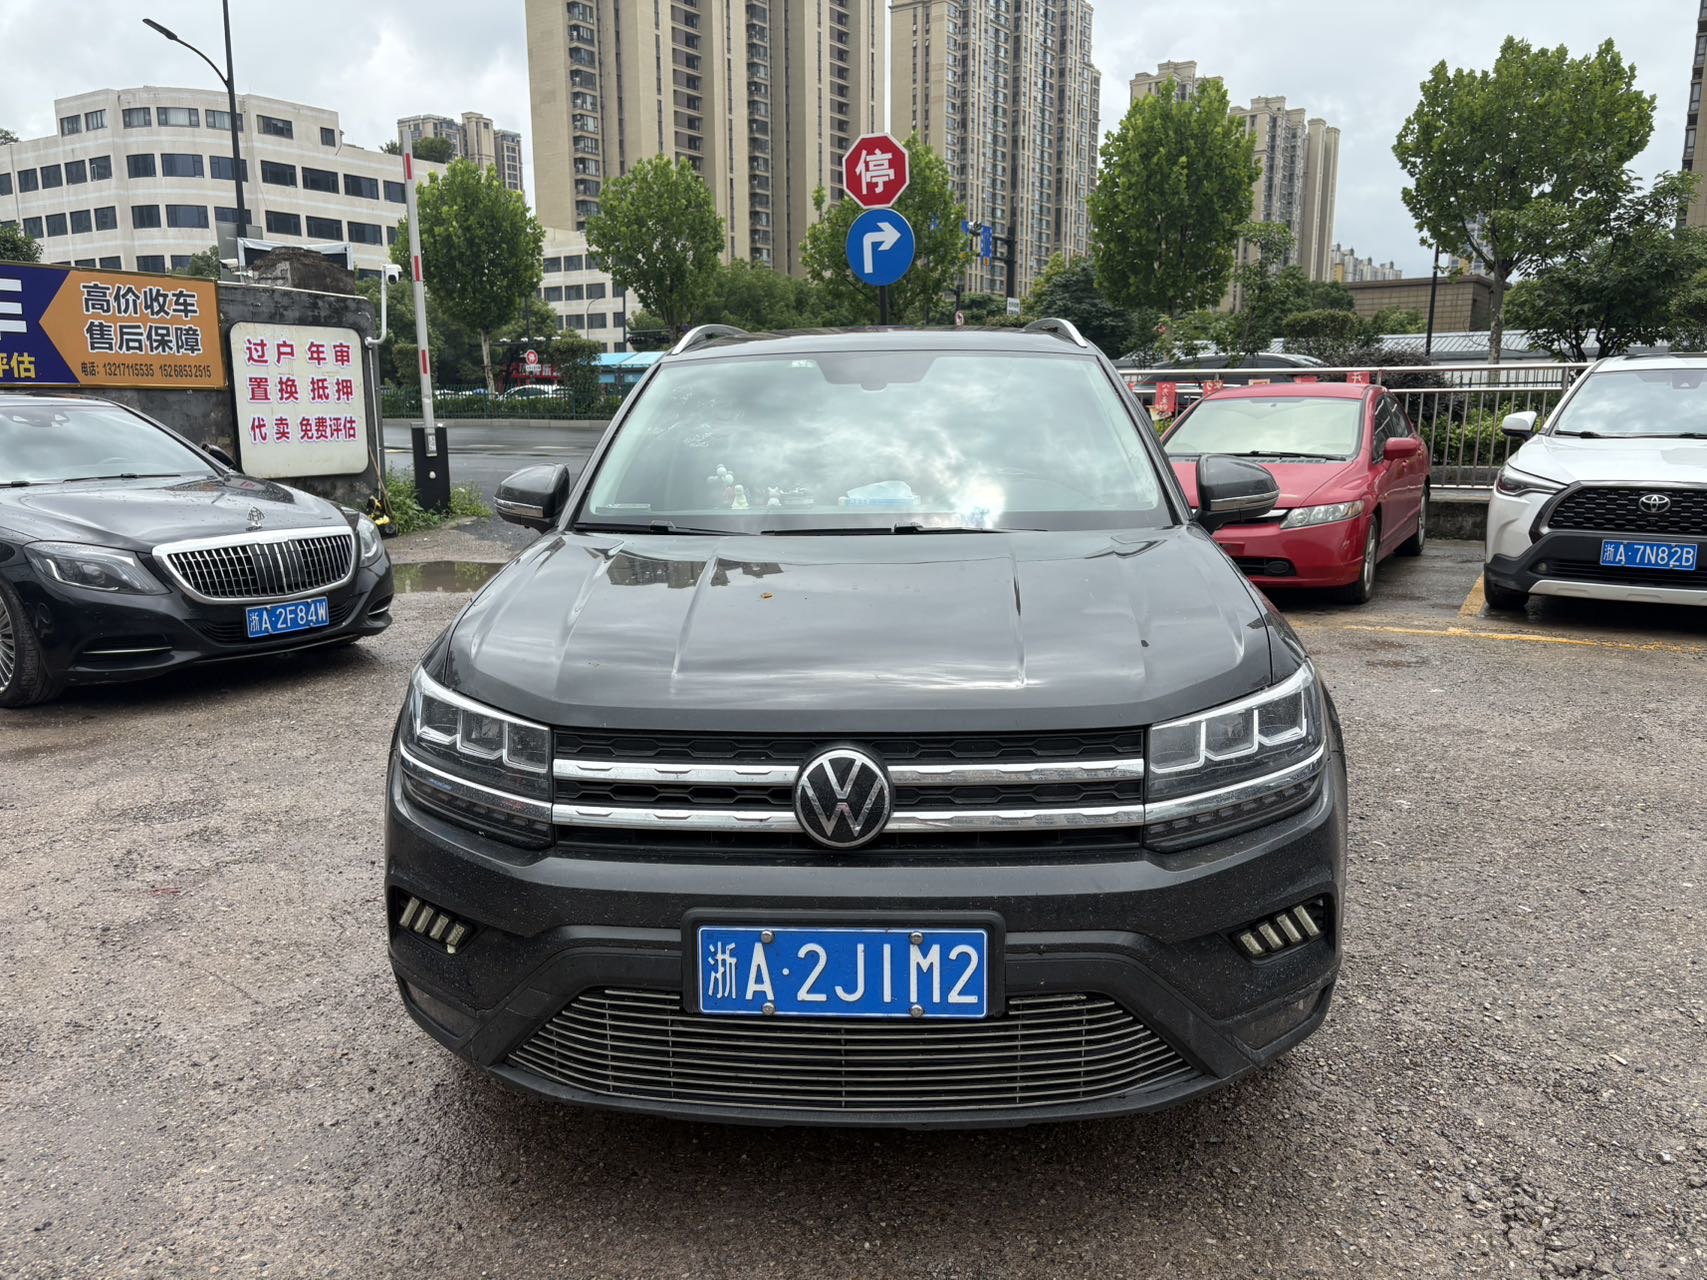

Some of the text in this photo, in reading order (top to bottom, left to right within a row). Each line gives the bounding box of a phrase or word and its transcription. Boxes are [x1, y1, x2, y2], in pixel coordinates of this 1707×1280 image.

[855, 148, 895, 195] 停
[81, 282, 199, 319] 高价收车
[85, 320, 202, 356] 售后保障
[245, 338, 351, 367] 过户 年审
[102, 362, 155, 377] 13217115535
[248, 376, 354, 402] 置换 抵押
[250, 416, 357, 441] 代卖 免费评估
[1603, 543, 1695, 567] 浙A·7N82B
[249, 601, 327, 632] 浙A·2F84W
[708, 941, 979, 1004] 浙A·2J1M2
